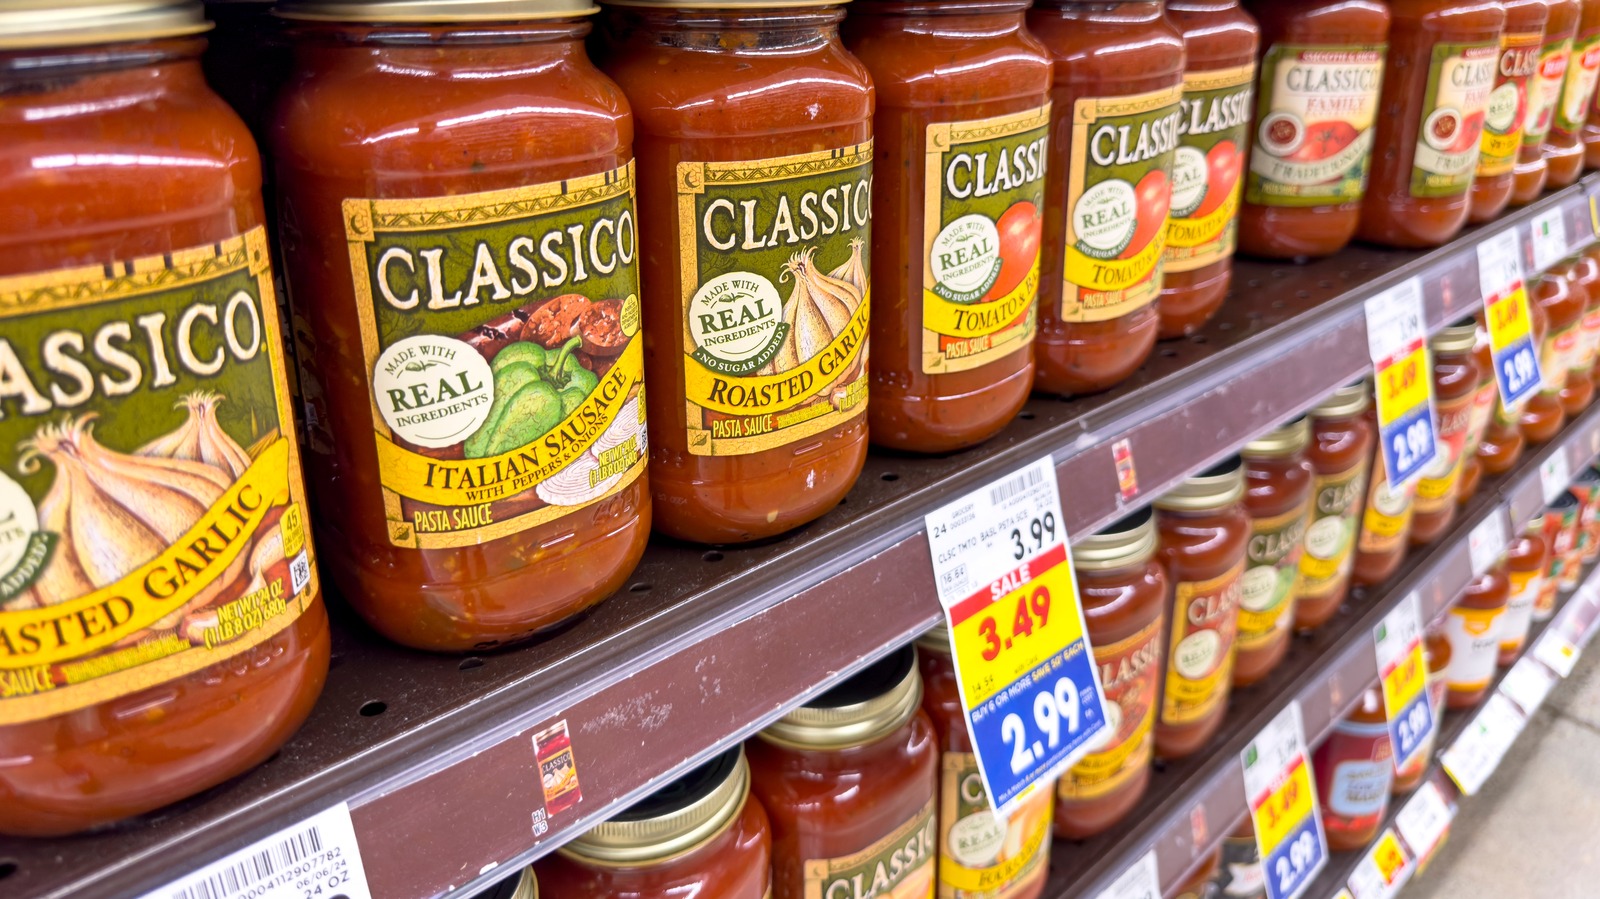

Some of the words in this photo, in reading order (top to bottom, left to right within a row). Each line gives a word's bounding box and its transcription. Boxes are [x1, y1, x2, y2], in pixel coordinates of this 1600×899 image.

[703, 180, 873, 251] CLASSIC
[1082, 201, 1130, 229] REAL
[941, 225, 965, 247] MADE
[966, 222, 985, 233] WITH
[377, 210, 635, 311] CLASSICO
[939, 237, 993, 271] REAL
[942, 255, 994, 281] INGREDIENTS
[938, 286, 953, 299] NO
[952, 292, 980, 302] SUGAR
[980, 264, 1000, 293] ADDED
[1092, 261, 1146, 285] TOMATO
[700, 282, 729, 306] MADE
[731, 279, 759, 293] WITH
[697, 298, 773, 335] REAL
[953, 297, 1017, 331] TOMATO
[703, 318, 776, 347] INGREDIENTS
[945, 341, 970, 358] PASTA
[384, 347, 417, 375] MADE
[418, 345, 457, 360] WITH
[700, 353, 717, 367] NO
[718, 361, 756, 373] SUGAR
[757, 331, 784, 365] ADDED
[707, 370, 813, 408] ROASTED
[819, 303, 868, 376] GARLIC
[1504, 348, 1534, 394] 2.99
[386, 370, 484, 412] REAL
[396, 393, 489, 427] INGREDIENTS
[712, 419, 742, 438] PASTA
[744, 414, 773, 436] SAUCE
[424, 446, 540, 490] ITALIAN
[544, 367, 627, 457] SAUSAGE
[1393, 418, 1429, 473] 2.99
[466, 486, 505, 501] WITH
[512, 458, 563, 490] PEPPERS
[563, 453, 572, 462] &
[571, 414, 609, 453] ONIONS
[286, 509, 298, 531] 45
[414, 507, 451, 532] PASTA
[453, 503, 494, 529] SAUCE
[933, 523, 947, 538] 24
[143, 484, 262, 600] GARLIC
[1011, 511, 1056, 561] 3.99
[938, 548, 957, 564] CLSC
[990, 564, 1033, 602] SALE
[217, 599, 241, 625] NET
[257, 587, 271, 606] 24
[218, 621, 234, 642] LB
[233, 617, 243, 635] 8
[263, 597, 287, 618] 680g
[978, 585, 1051, 661] 3.49
[0, 664, 56, 697] SAUCE
[972, 705, 990, 723] BUY
[988, 702, 996, 713] 6
[995, 691, 1009, 708] OR
[1008, 677, 1032, 699] MORE
[1031, 663, 1051, 682] SAVE
[1063, 641, 1085, 660] EACH
[1001, 676, 1079, 776] 2.99
[1398, 701, 1428, 752] 2.99
[532, 808, 546, 824] H1
[532, 820, 548, 836] W3
[296, 859, 347, 889] 06/06/24
[1275, 830, 1315, 893] 2.99
[304, 884, 323, 899] 24
[327, 869, 350, 889] OZ
